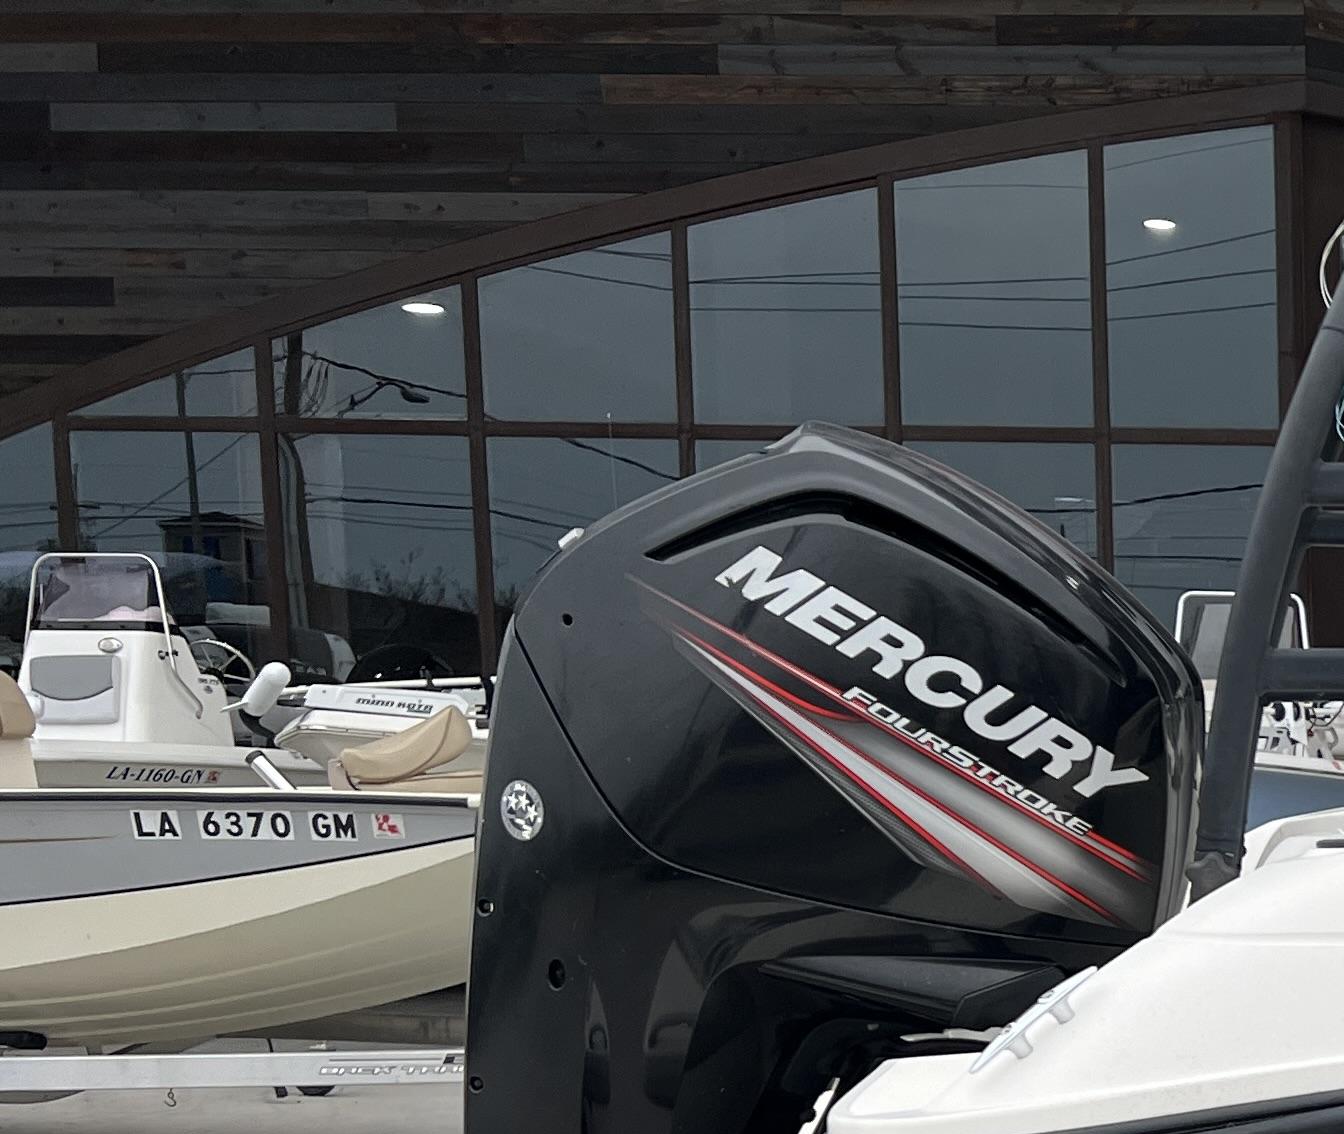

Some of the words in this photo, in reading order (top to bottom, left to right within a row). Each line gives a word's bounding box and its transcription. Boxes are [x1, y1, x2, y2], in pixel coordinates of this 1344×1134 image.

[714, 545, 1149, 798] MERCURY
[105, 766, 205, 784] LA-1160-GN
[842, 686, 1093, 835] FOURSTROKE
[133, 812, 179, 838] LA
[202, 811, 291, 839] 6370
[311, 813, 357, 839] GM
